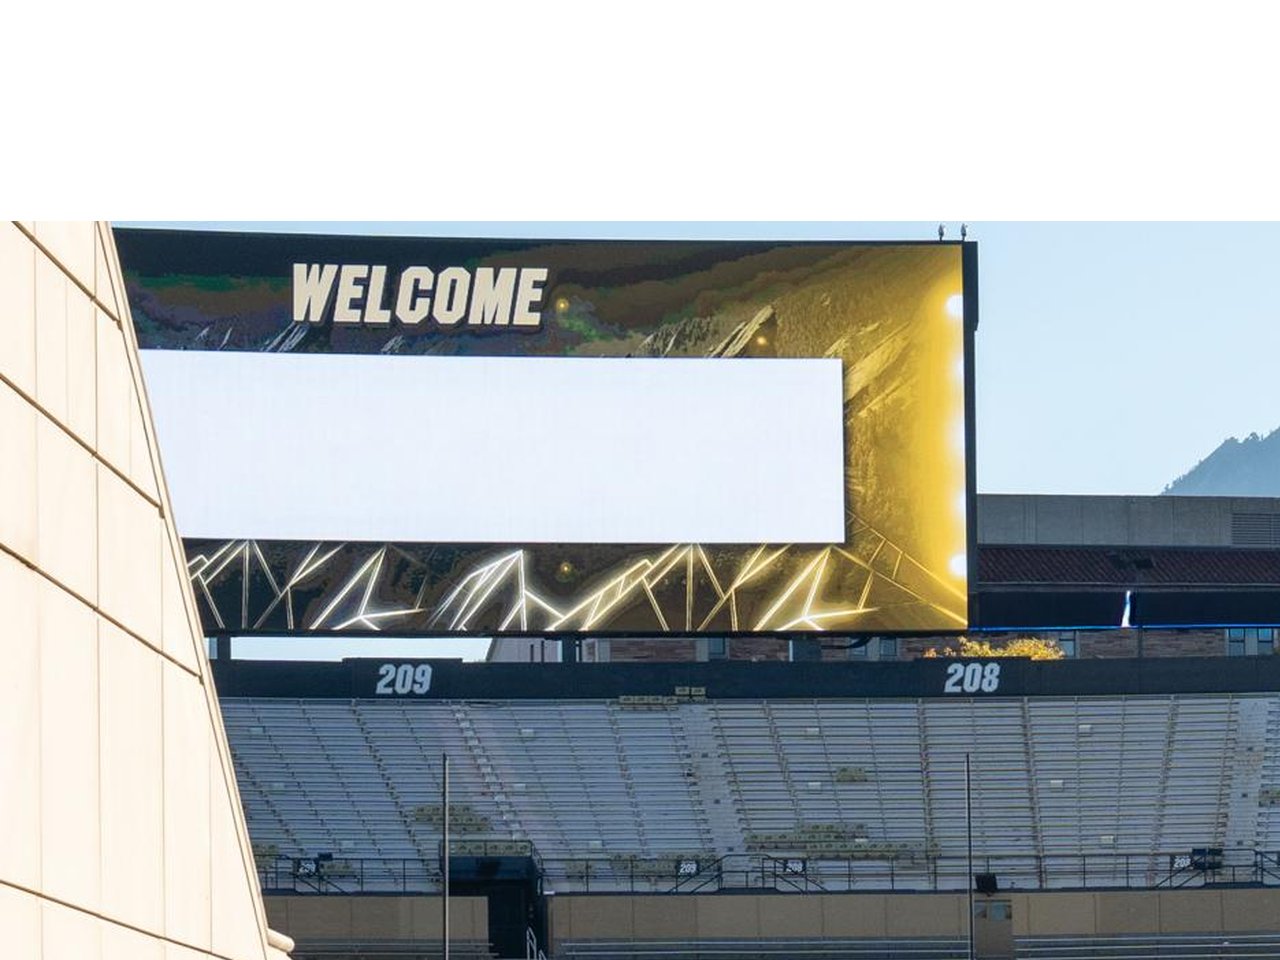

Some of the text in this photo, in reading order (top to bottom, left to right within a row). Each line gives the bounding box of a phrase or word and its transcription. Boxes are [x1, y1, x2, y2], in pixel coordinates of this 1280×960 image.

[293, 263, 549, 326] WELCOME
[375, 664, 433, 694] 209
[943, 662, 1001, 693] 208
